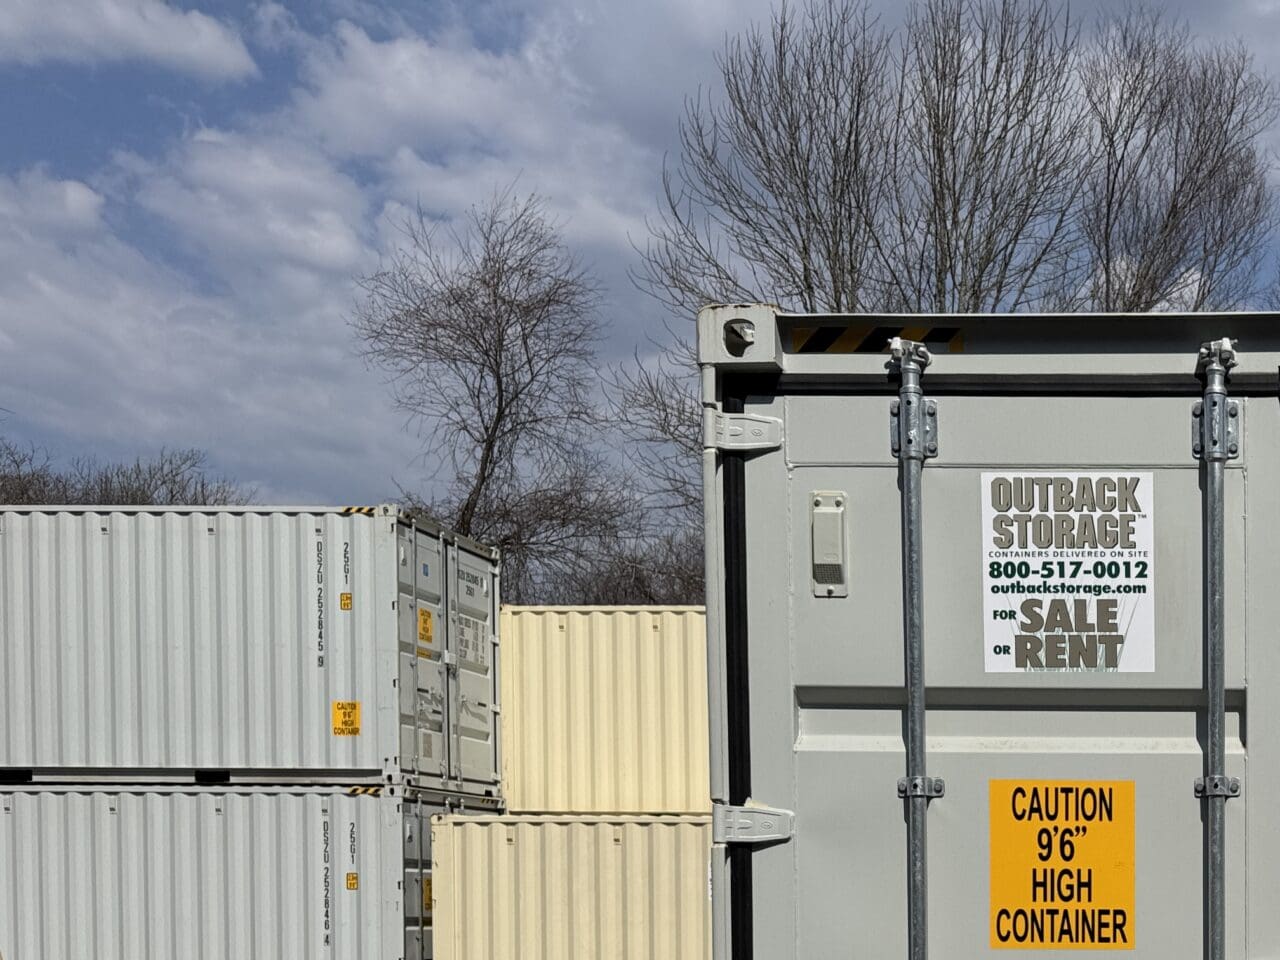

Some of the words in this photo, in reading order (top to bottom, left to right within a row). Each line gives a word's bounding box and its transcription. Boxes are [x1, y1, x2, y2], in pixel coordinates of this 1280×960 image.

[990, 476, 1142, 513] OUTBACK
[992, 513, 1137, 550] STORAGE
[988, 561, 1148, 579] 800-517-0012
[990, 581, 1147, 596] outbackstorage.com
[993, 610, 1017, 620] FOR
[1020, 598, 1119, 633] SALE
[993, 645, 1011, 655] OR
[1014, 634, 1125, 669] RENT
[1011, 787, 1113, 821] CAUTION
[1032, 868, 1092, 902] HIGH
[996, 908, 1128, 943] CONTAINER
